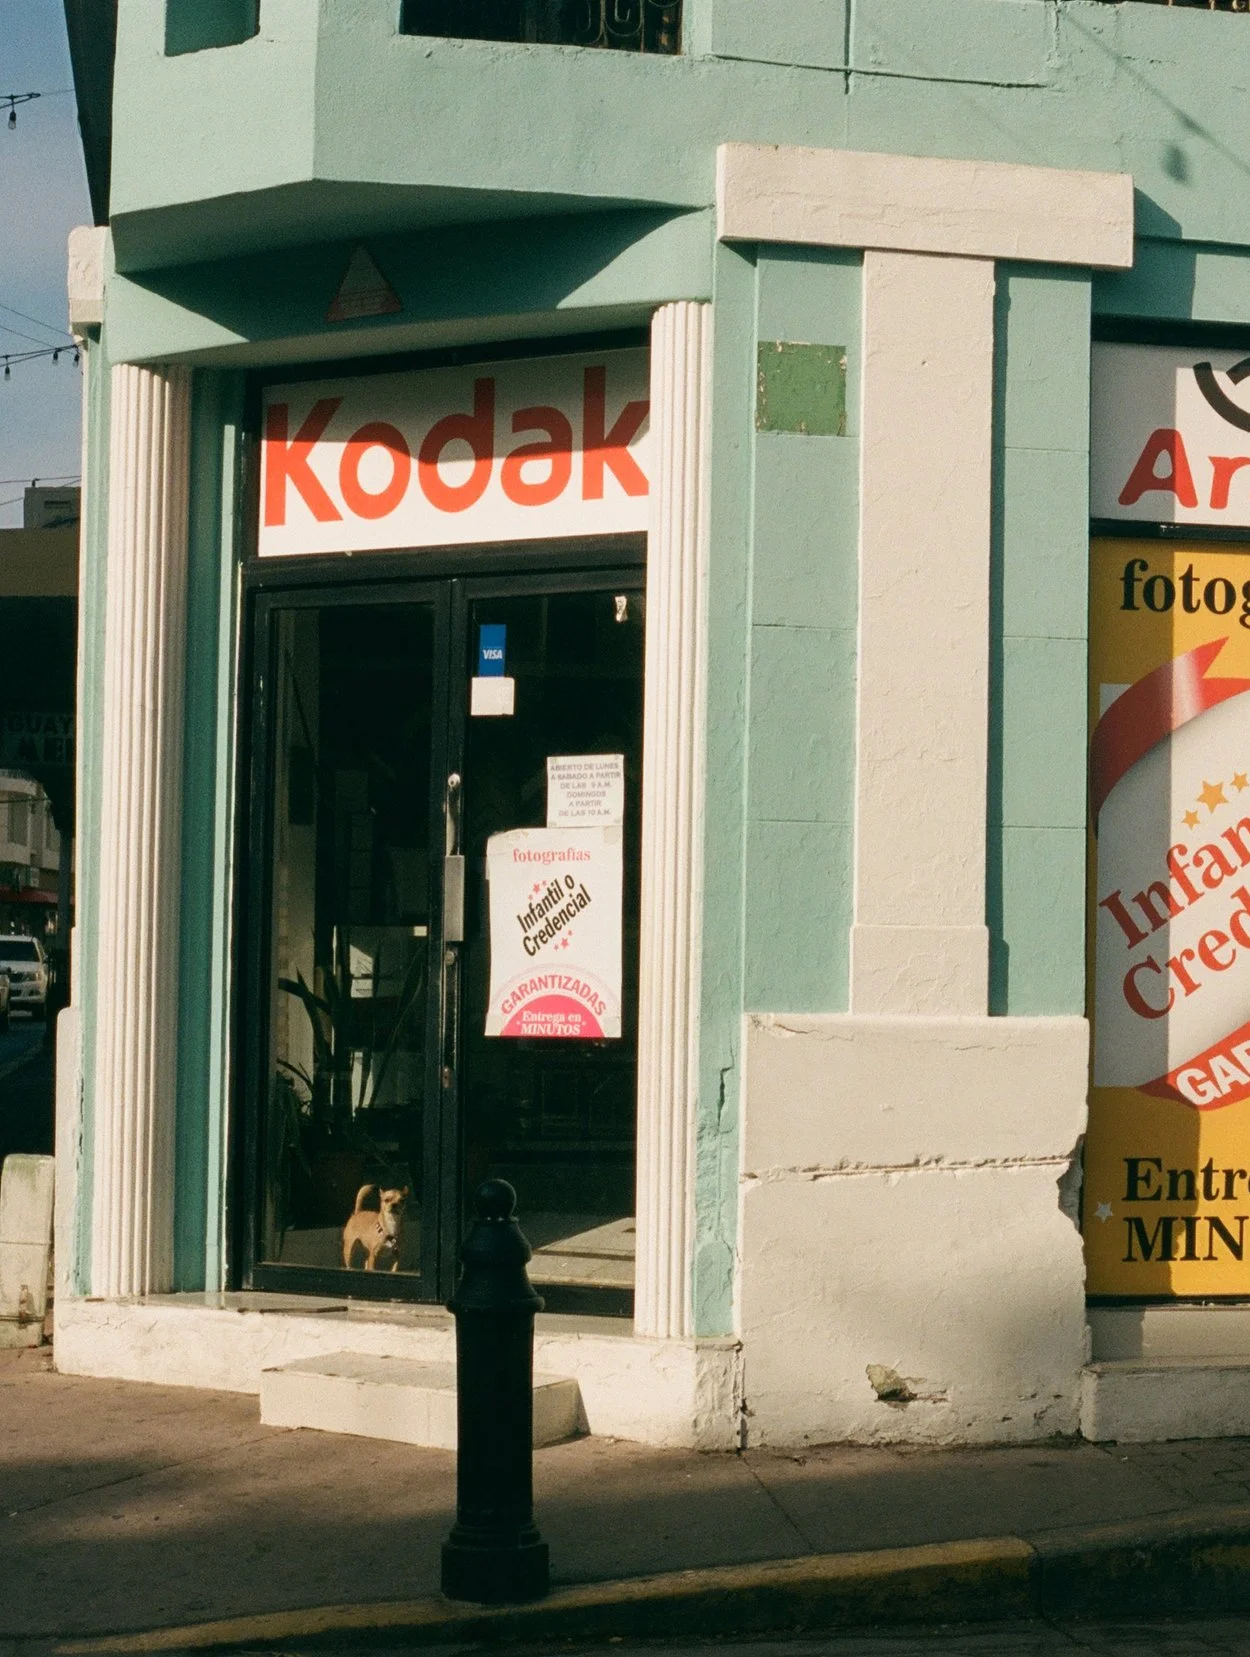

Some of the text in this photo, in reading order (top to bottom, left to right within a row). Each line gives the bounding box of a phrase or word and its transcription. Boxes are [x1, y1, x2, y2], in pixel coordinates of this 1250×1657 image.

[264, 366, 649, 527] Kodak
[482, 649, 503, 660] VISA
[517, 874, 575, 933] Infantil o
[523, 884, 592, 957] Credencial
[502, 975, 605, 1016] GARANTIZADAS
[521, 1022, 580, 1036] MINUTOS
[522, 1011, 581, 1024] Entrega en
